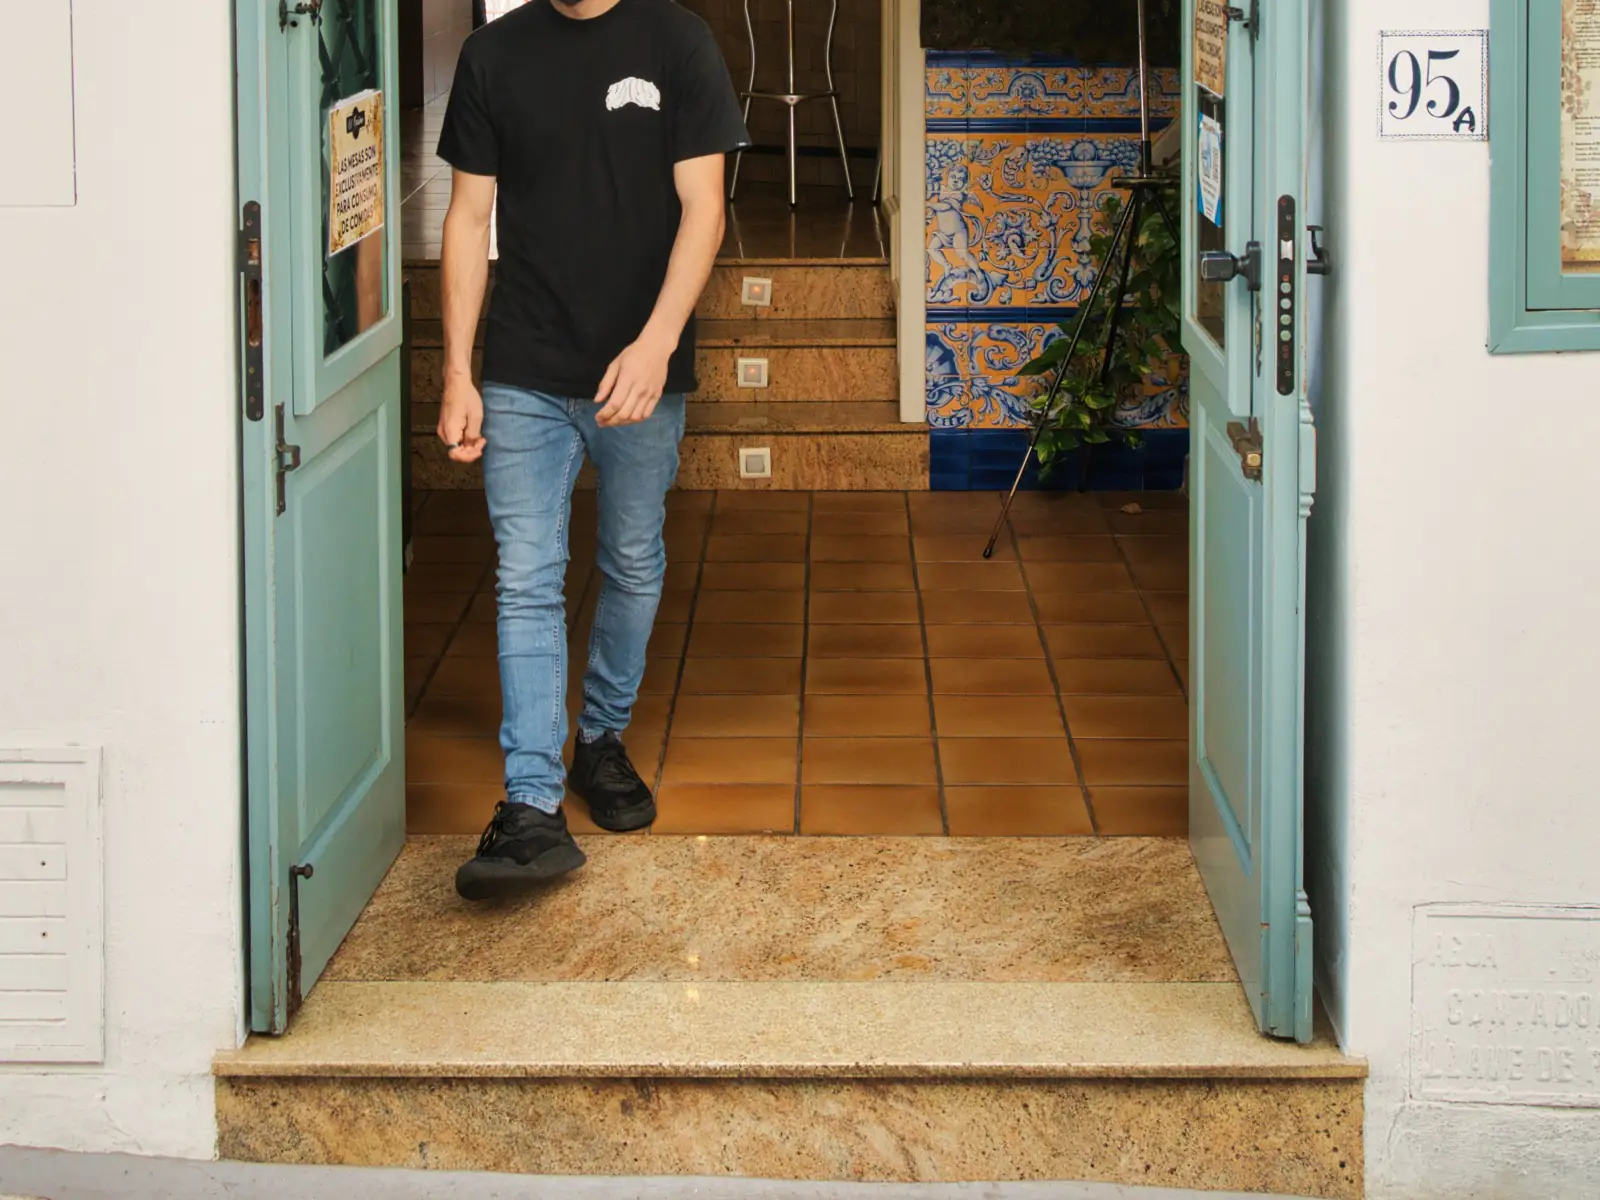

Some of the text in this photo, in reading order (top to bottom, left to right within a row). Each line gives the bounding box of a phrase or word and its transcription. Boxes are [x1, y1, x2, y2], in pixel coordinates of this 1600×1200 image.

[337, 144, 376, 175] LAS MESAS SON
[336, 182, 378, 217] PARA CONSUMO
[341, 204, 374, 236] DE COMIDAS
[1447, 989, 1600, 1028] CONTADO
